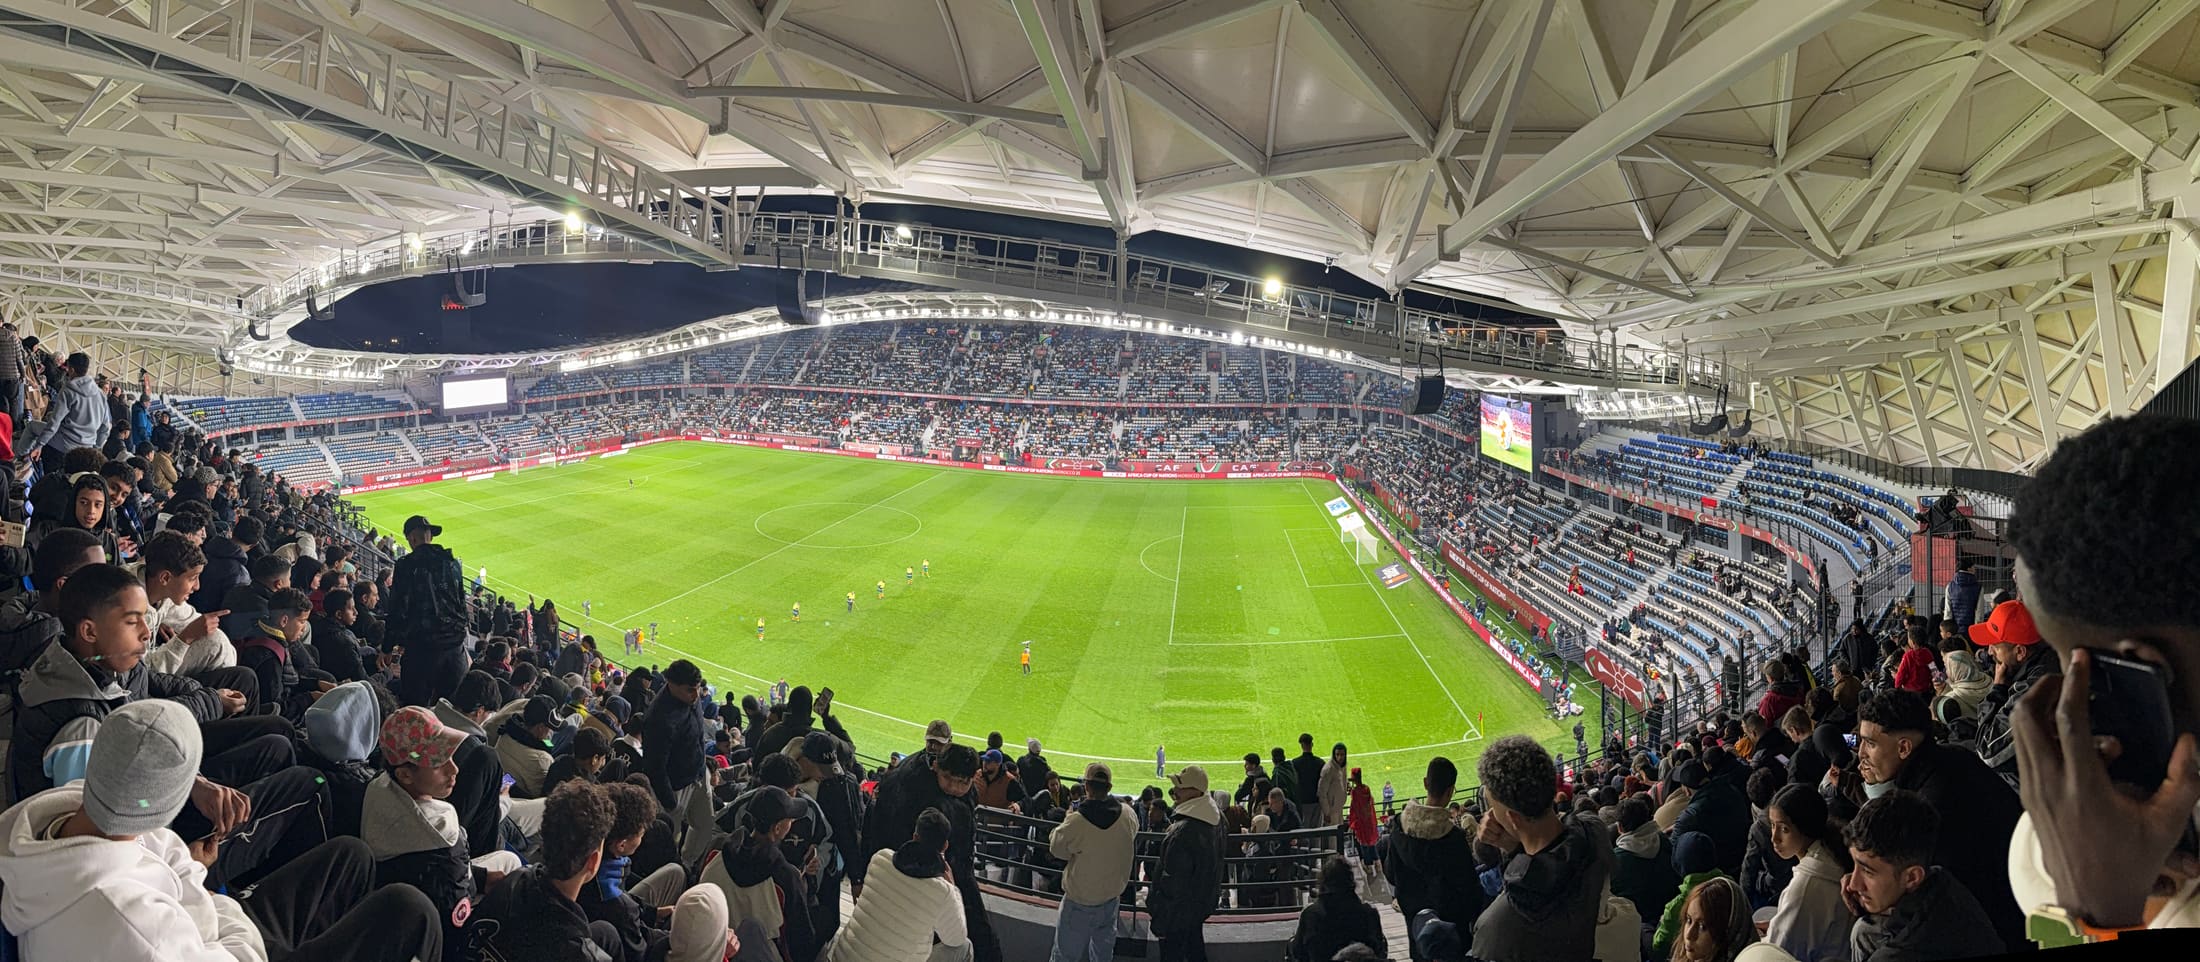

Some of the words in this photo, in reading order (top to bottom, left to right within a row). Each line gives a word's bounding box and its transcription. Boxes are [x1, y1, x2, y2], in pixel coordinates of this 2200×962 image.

[1465, 563, 1478, 578] AFRICA
[1489, 583, 1506, 601] NATIONS
[1513, 658, 1530, 680] AFRICA
[1530, 673, 1541, 688] CUP
